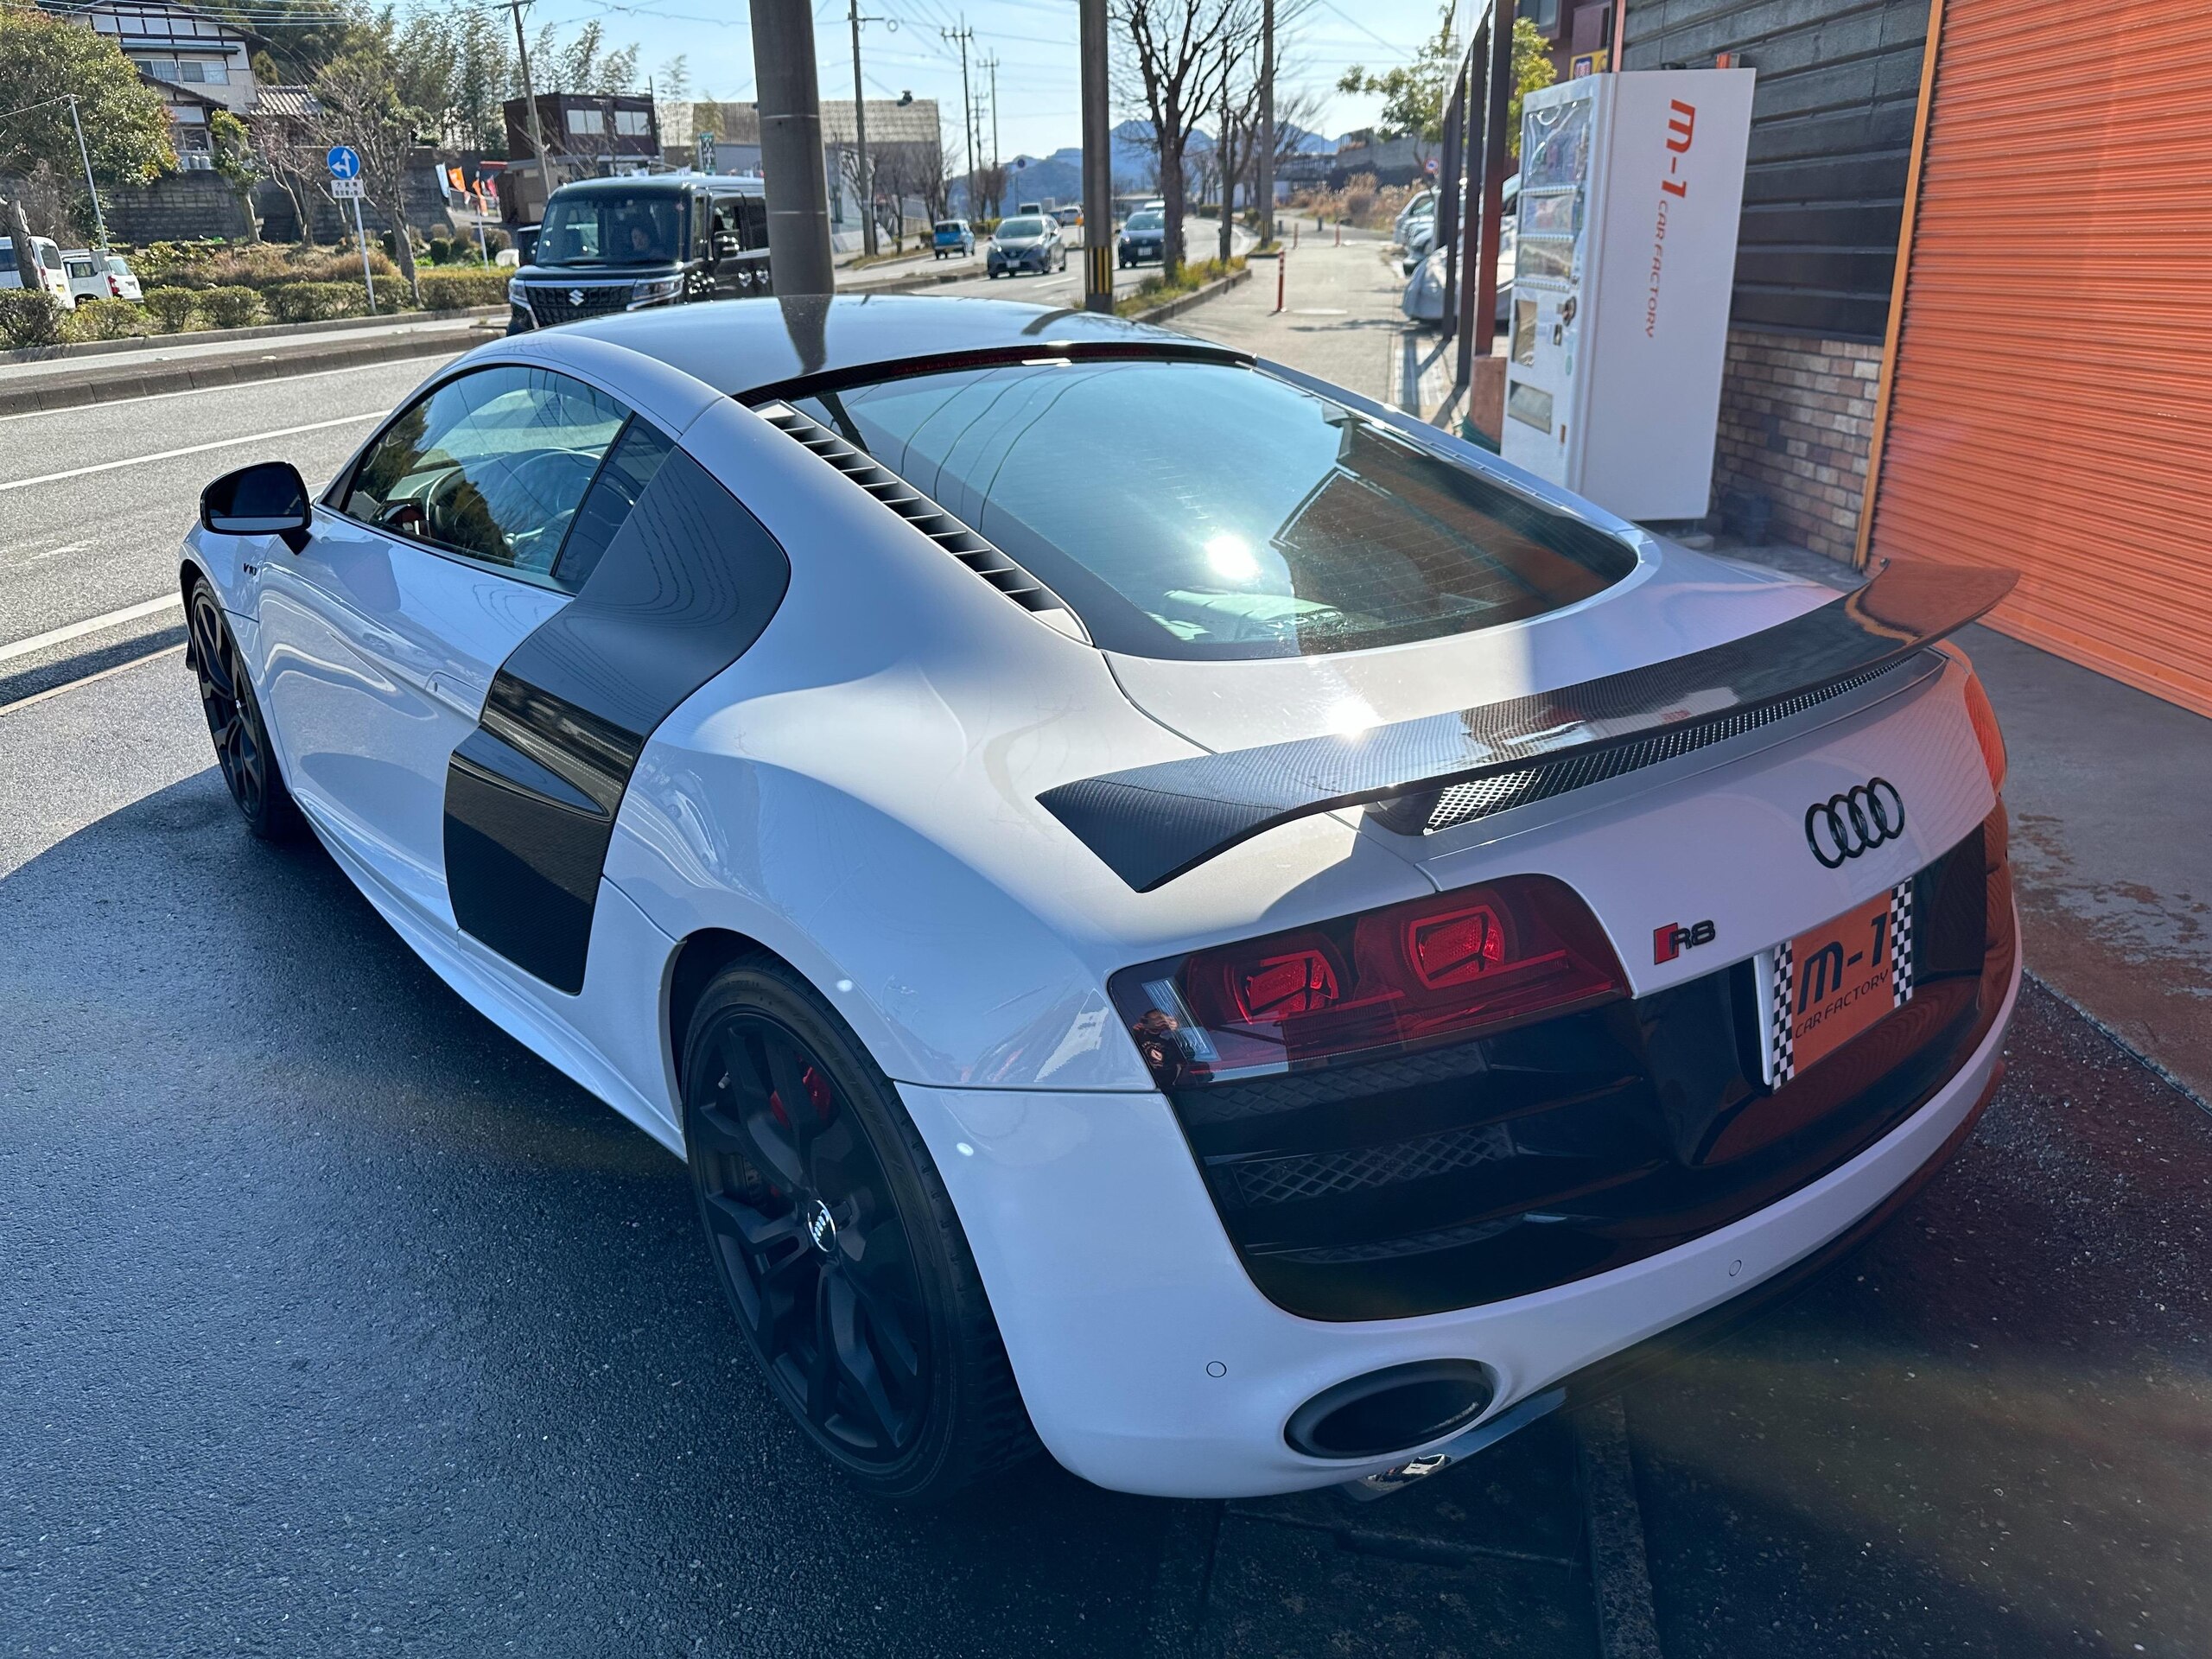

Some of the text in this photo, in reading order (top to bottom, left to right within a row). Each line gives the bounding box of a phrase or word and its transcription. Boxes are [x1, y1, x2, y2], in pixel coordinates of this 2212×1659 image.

[1645, 200, 1669, 338] CAR FACTORY
[243, 563, 257, 575] V10
[1669, 919, 1716, 955] R8
[1795, 969, 1889, 1039] CAR FACTORY
